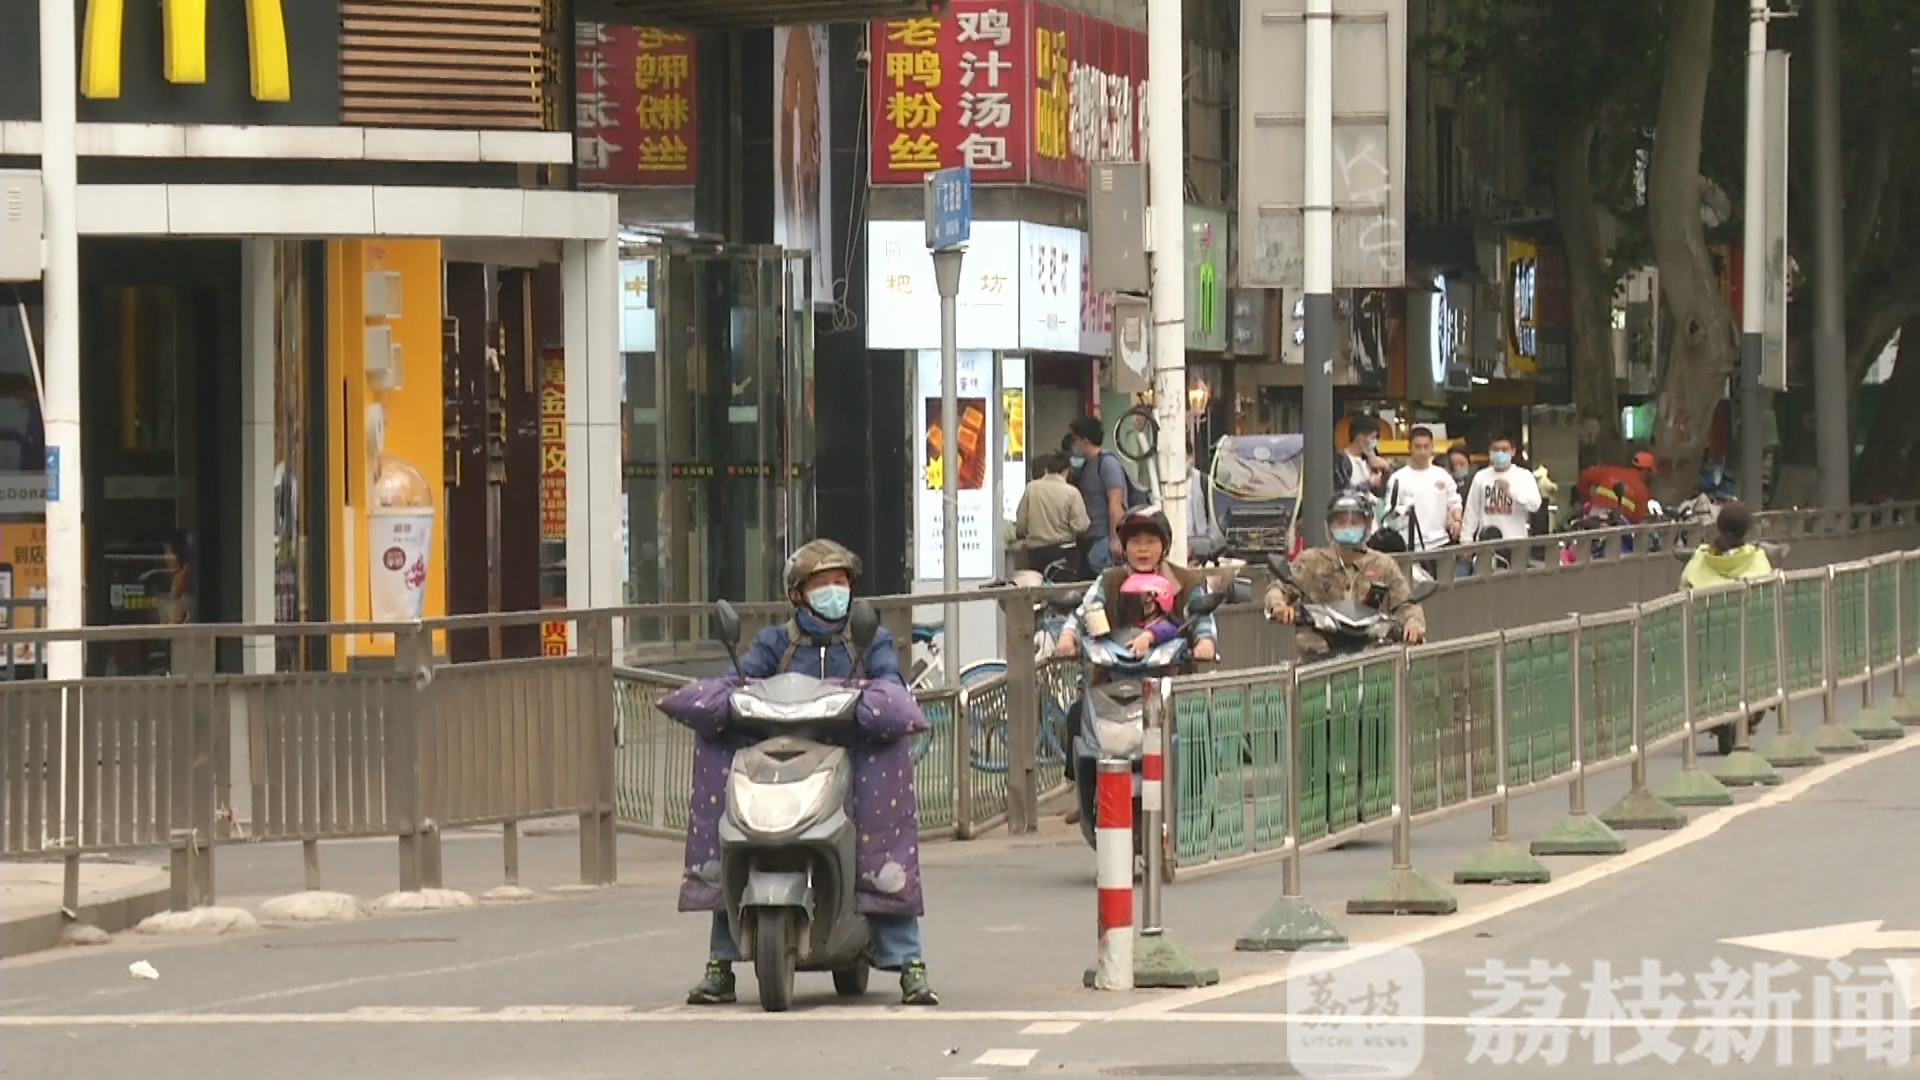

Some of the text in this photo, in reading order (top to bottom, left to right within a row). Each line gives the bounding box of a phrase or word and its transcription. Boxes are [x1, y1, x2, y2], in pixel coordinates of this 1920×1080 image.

[886, 17, 942, 171] 老鸭粉丝
[956, 8, 1012, 170] 鸡汁汤包
[886, 273, 1008, 295] 粑坊
